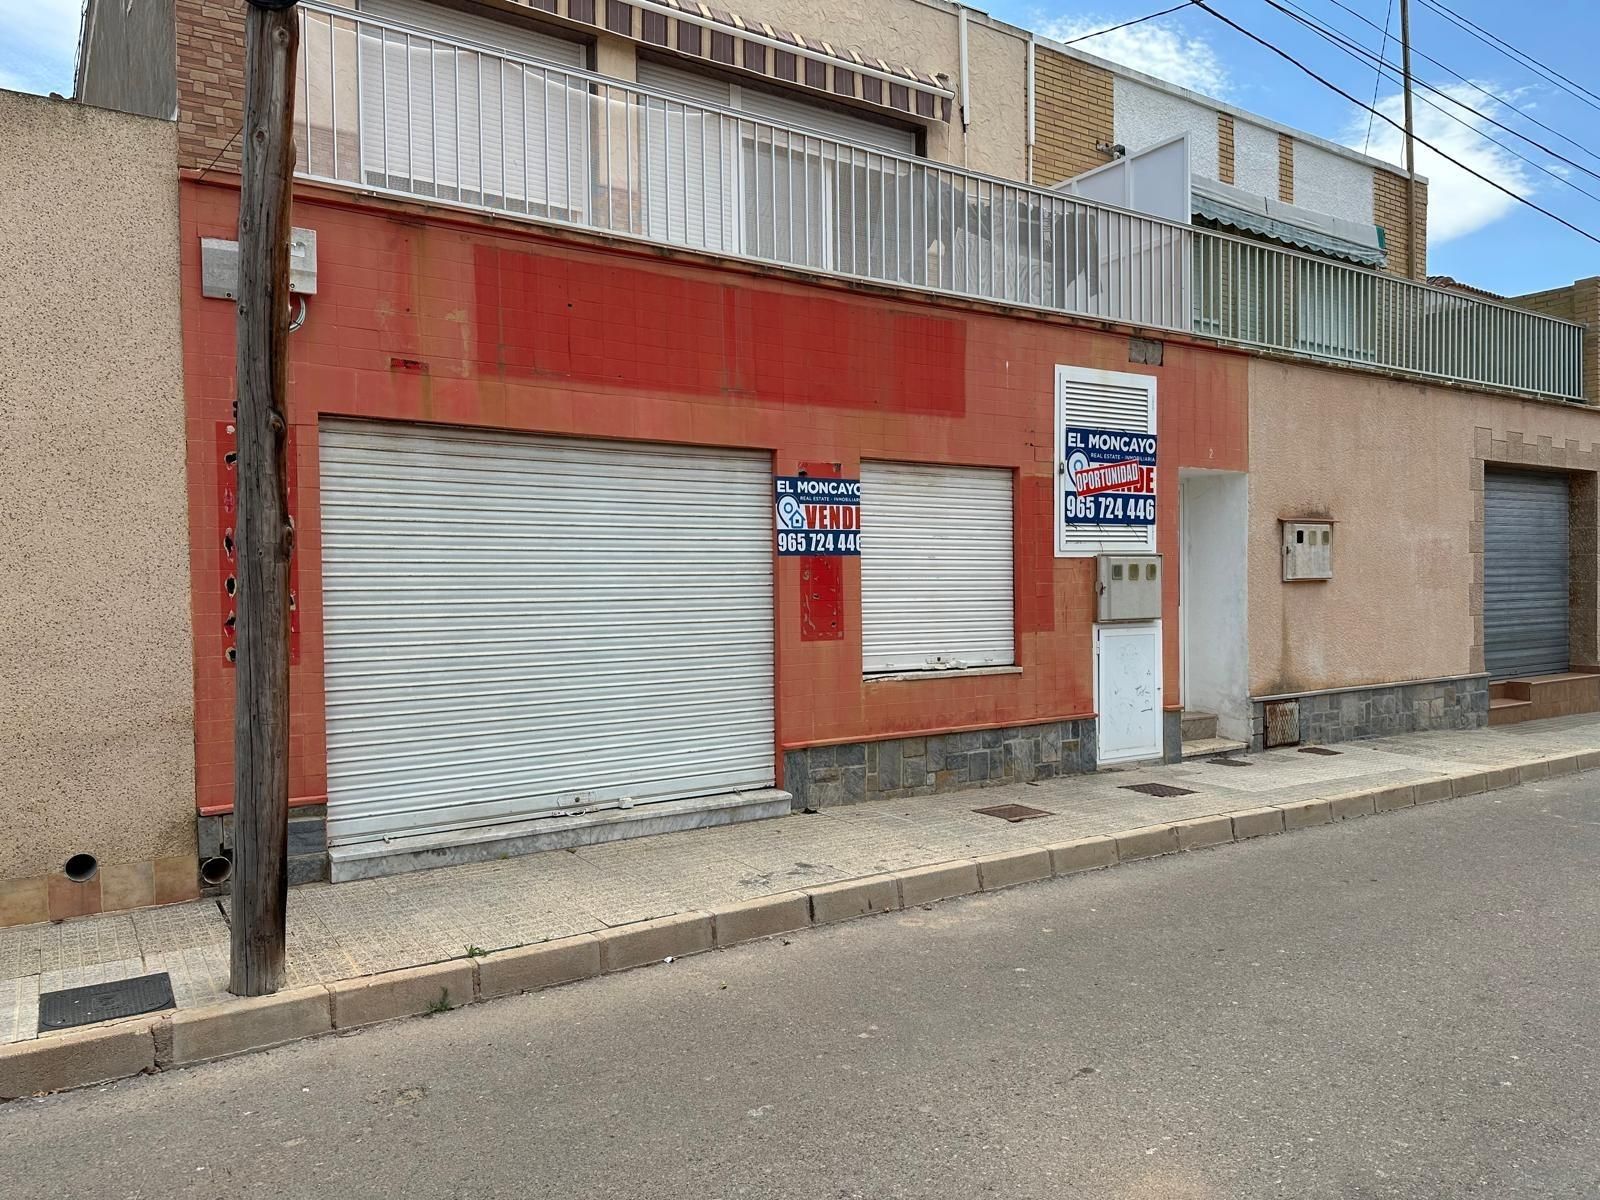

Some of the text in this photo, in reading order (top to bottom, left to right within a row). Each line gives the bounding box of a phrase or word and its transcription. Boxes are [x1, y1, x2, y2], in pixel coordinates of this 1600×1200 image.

[1067, 432, 1156, 454] EL MONCAYO
[777, 480, 794, 493] EL
[1076, 463, 1139, 492] OPORTUNIDAD
[1066, 495, 1155, 520] 965 724 446
[778, 533, 806, 552] 965
[809, 533, 834, 552] 724
